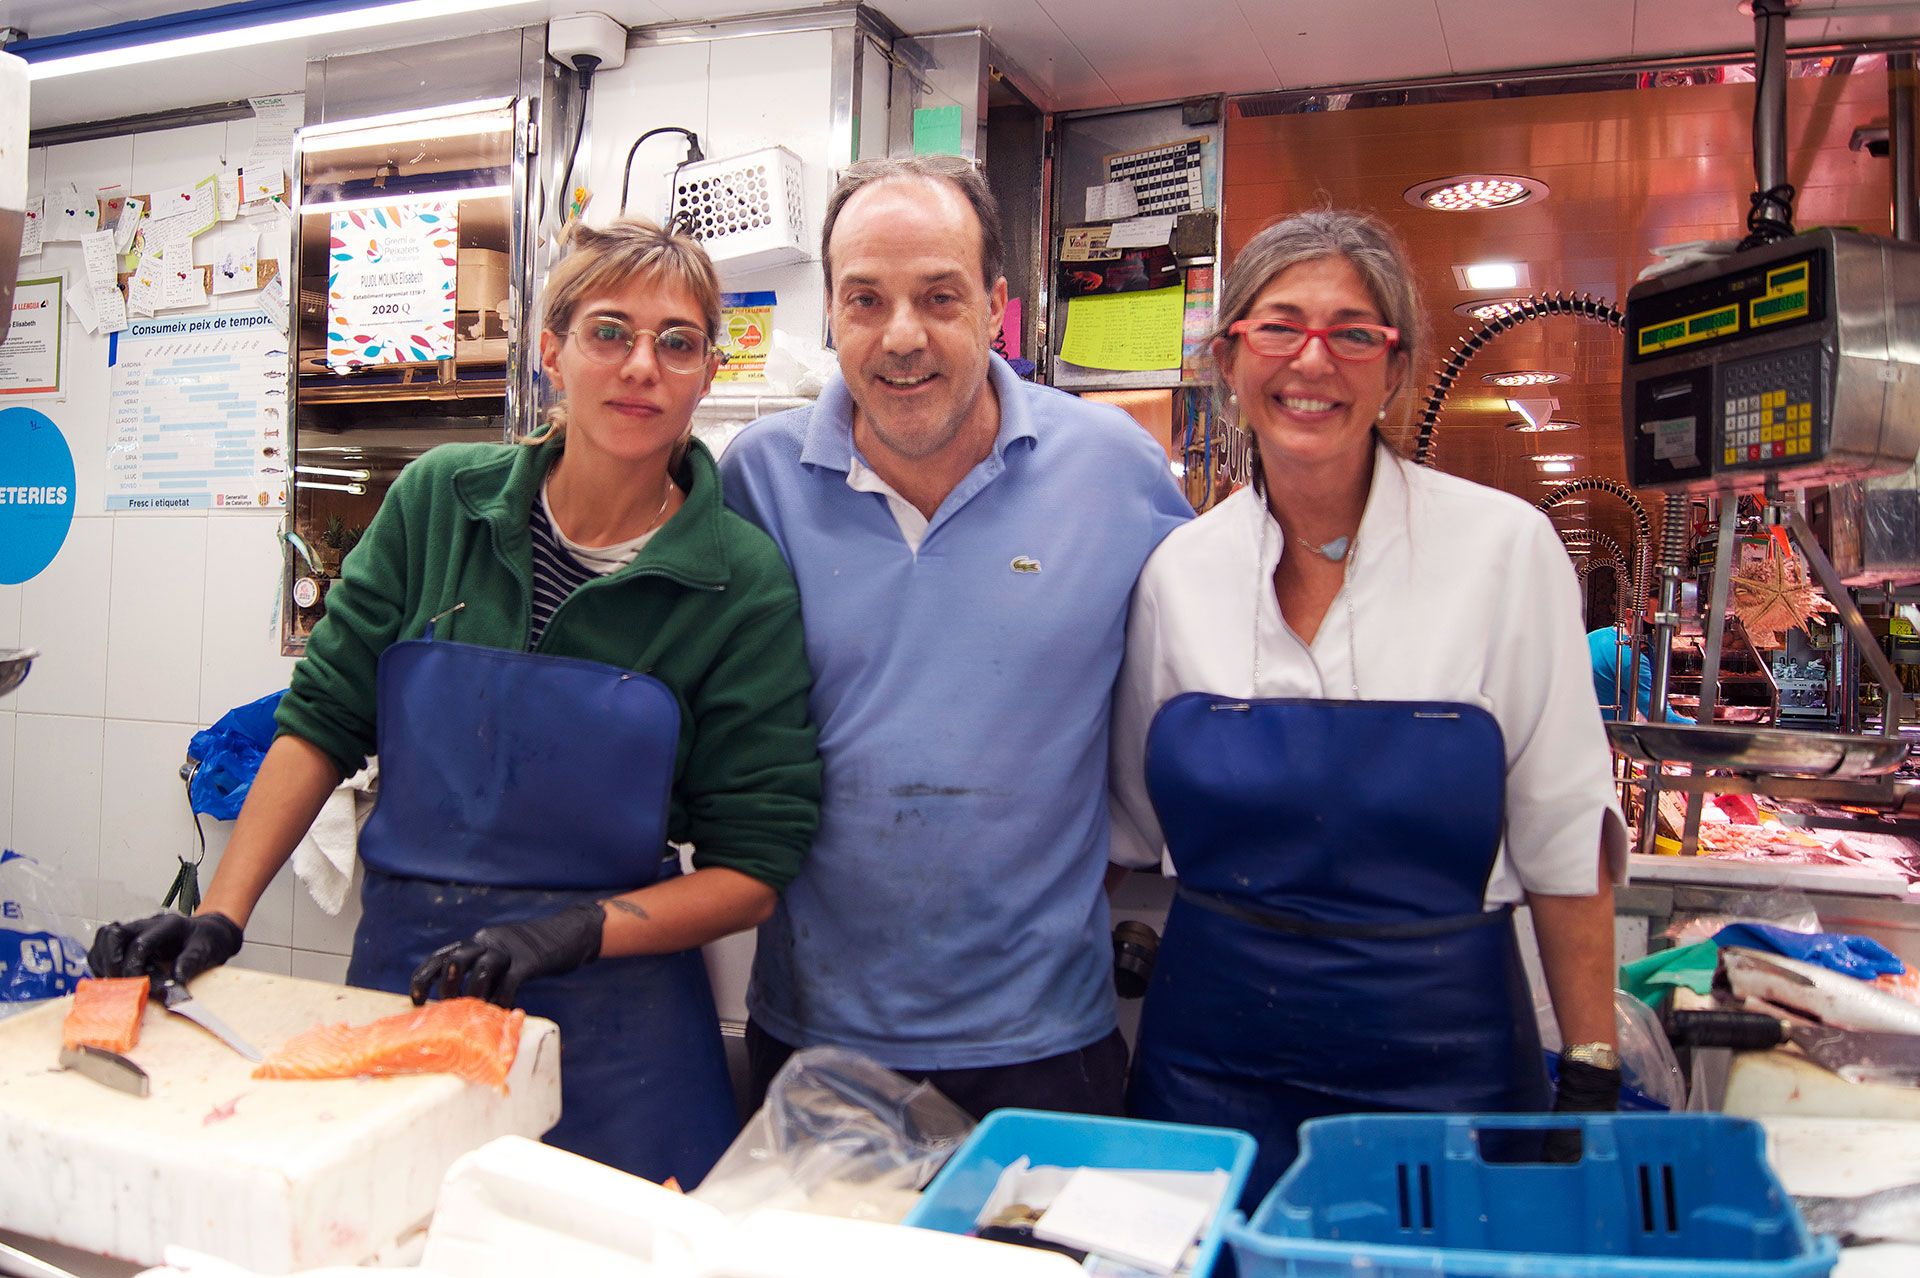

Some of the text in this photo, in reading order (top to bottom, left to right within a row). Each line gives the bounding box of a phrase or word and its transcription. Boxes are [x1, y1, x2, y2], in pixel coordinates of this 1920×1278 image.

[384, 236, 408, 246] Gremi
[384, 246, 420, 256] Peixaters
[360, 270, 424, 288] PUJOL MOLINS Elisabeth
[353, 292, 384, 300] Establiment
[385, 291, 408, 299] agremiat
[18, 302, 40, 310] LLENGUA
[372, 302, 410, 315] 2020 Q
[12, 320, 36, 328] Elisabeth
[132, 322, 186, 336] Consumeix
[189, 319, 211, 332] peix
[214, 318, 226, 328] de
[0, 486, 68, 505] ETERIES
[128, 498, 190, 508] Fresc i etiquetat
